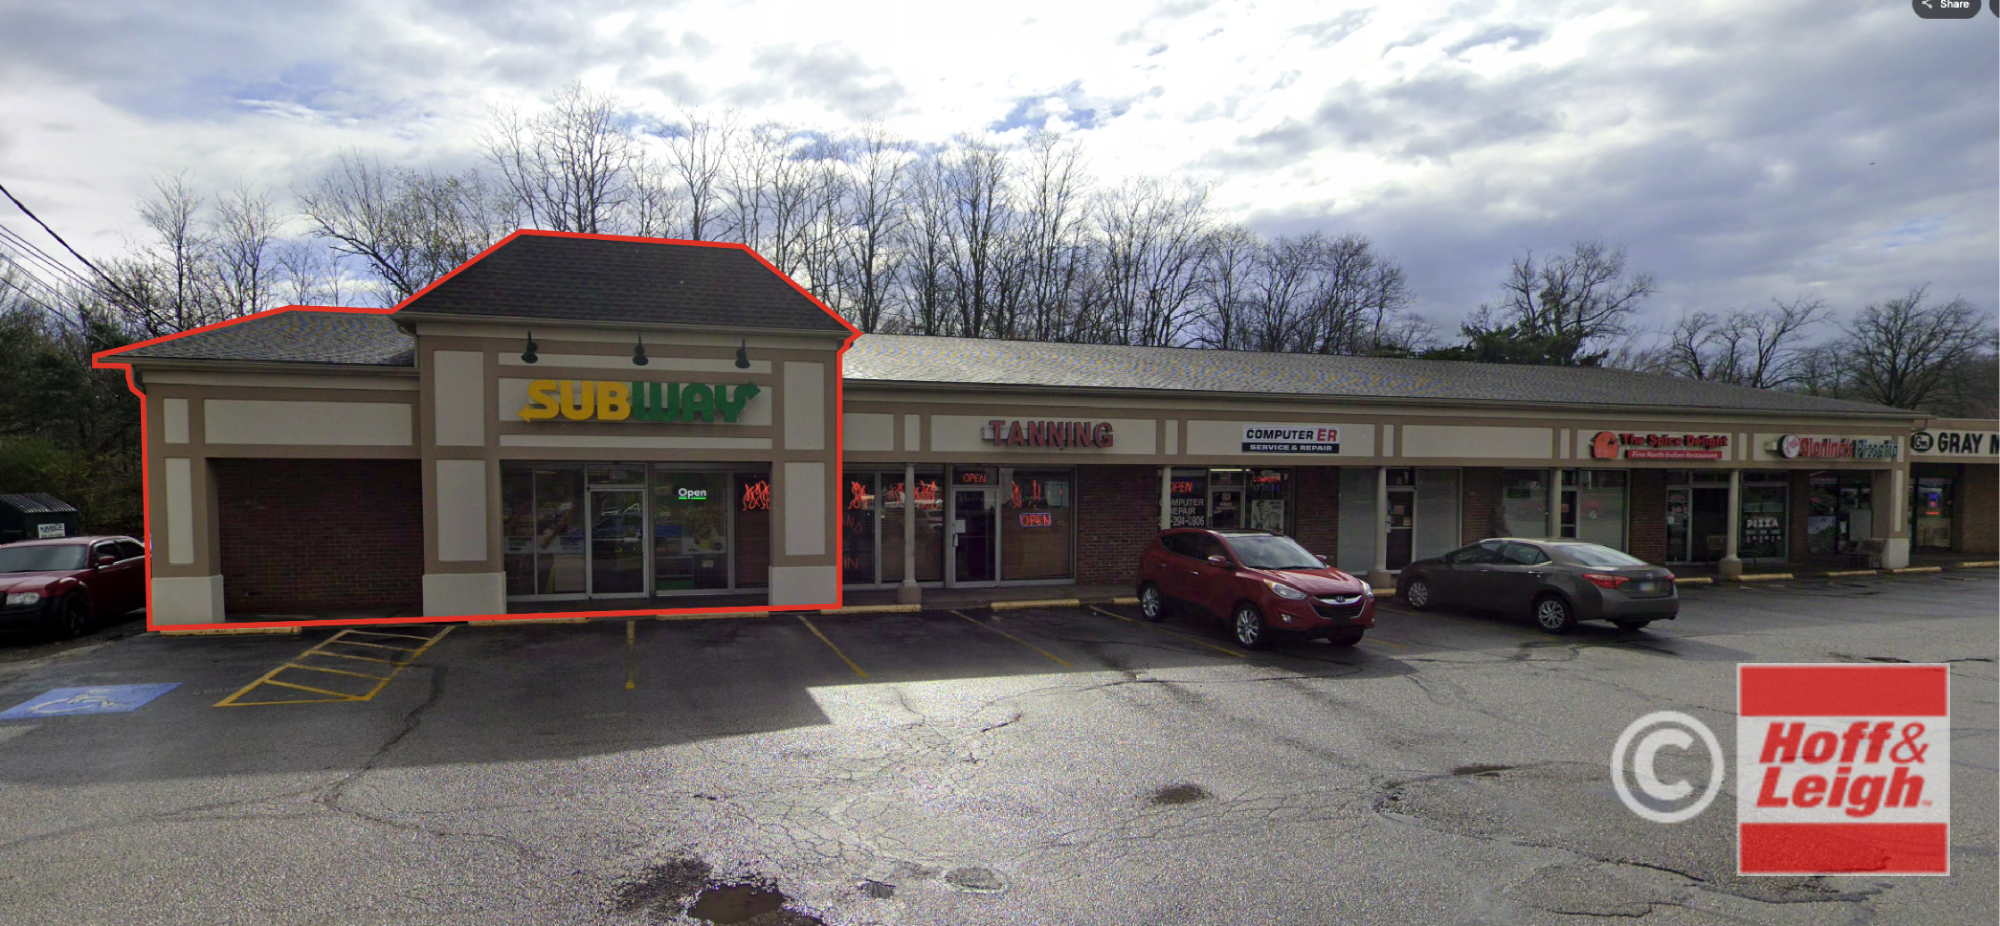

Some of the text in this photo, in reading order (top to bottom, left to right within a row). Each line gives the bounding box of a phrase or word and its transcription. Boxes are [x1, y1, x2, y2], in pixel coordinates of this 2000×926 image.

[517, 379, 761, 423] SUBWAY
[988, 420, 1114, 448] TANNING
[1246, 428, 1338, 442] COMPUTER ER
[1249, 443, 1290, 451] SERVICE
[1299, 444, 1333, 452] REPAIR
[1622, 433, 1728, 449] The Spice Delight
[1938, 432, 1983, 454] GRAY
[1631, 450, 1646, 458] Fine
[1647, 450, 1664, 458] North
[962, 473, 986, 484] OPEN
[678, 488, 708, 500] Open
[1021, 514, 1051, 527] OPEN
[1746, 518, 1779, 528] PIZZA
